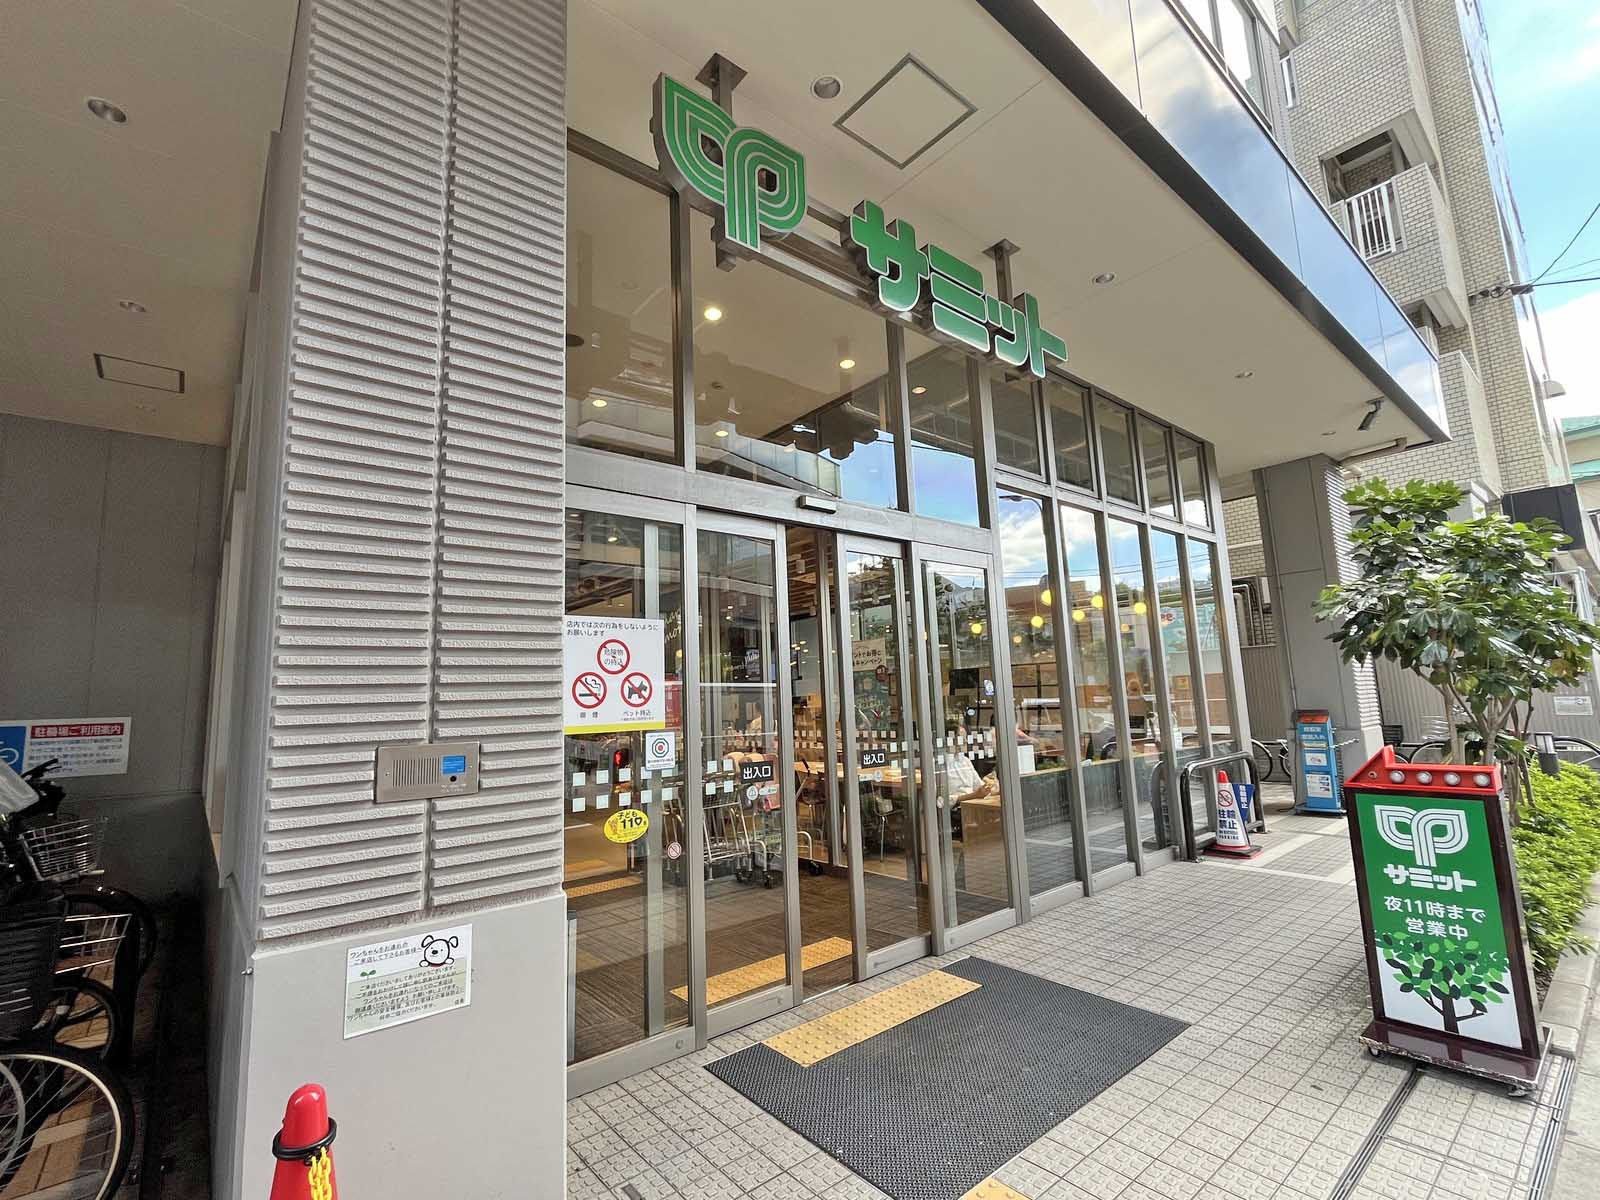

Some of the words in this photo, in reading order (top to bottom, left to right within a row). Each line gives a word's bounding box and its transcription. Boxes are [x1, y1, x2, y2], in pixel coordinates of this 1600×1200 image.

[850, 199, 1068, 378] サミット
[566, 620, 659, 631] 店内では次の行為をしないように
[567, 629, 605, 637] お願いします
[863, 753, 885, 765] 出入口
[743, 765, 771, 780] 出入口
[1383, 863, 1477, 893] サミット
[1383, 895, 1487, 924] 夜11時まで
[1405, 916, 1469, 941] 営業中
